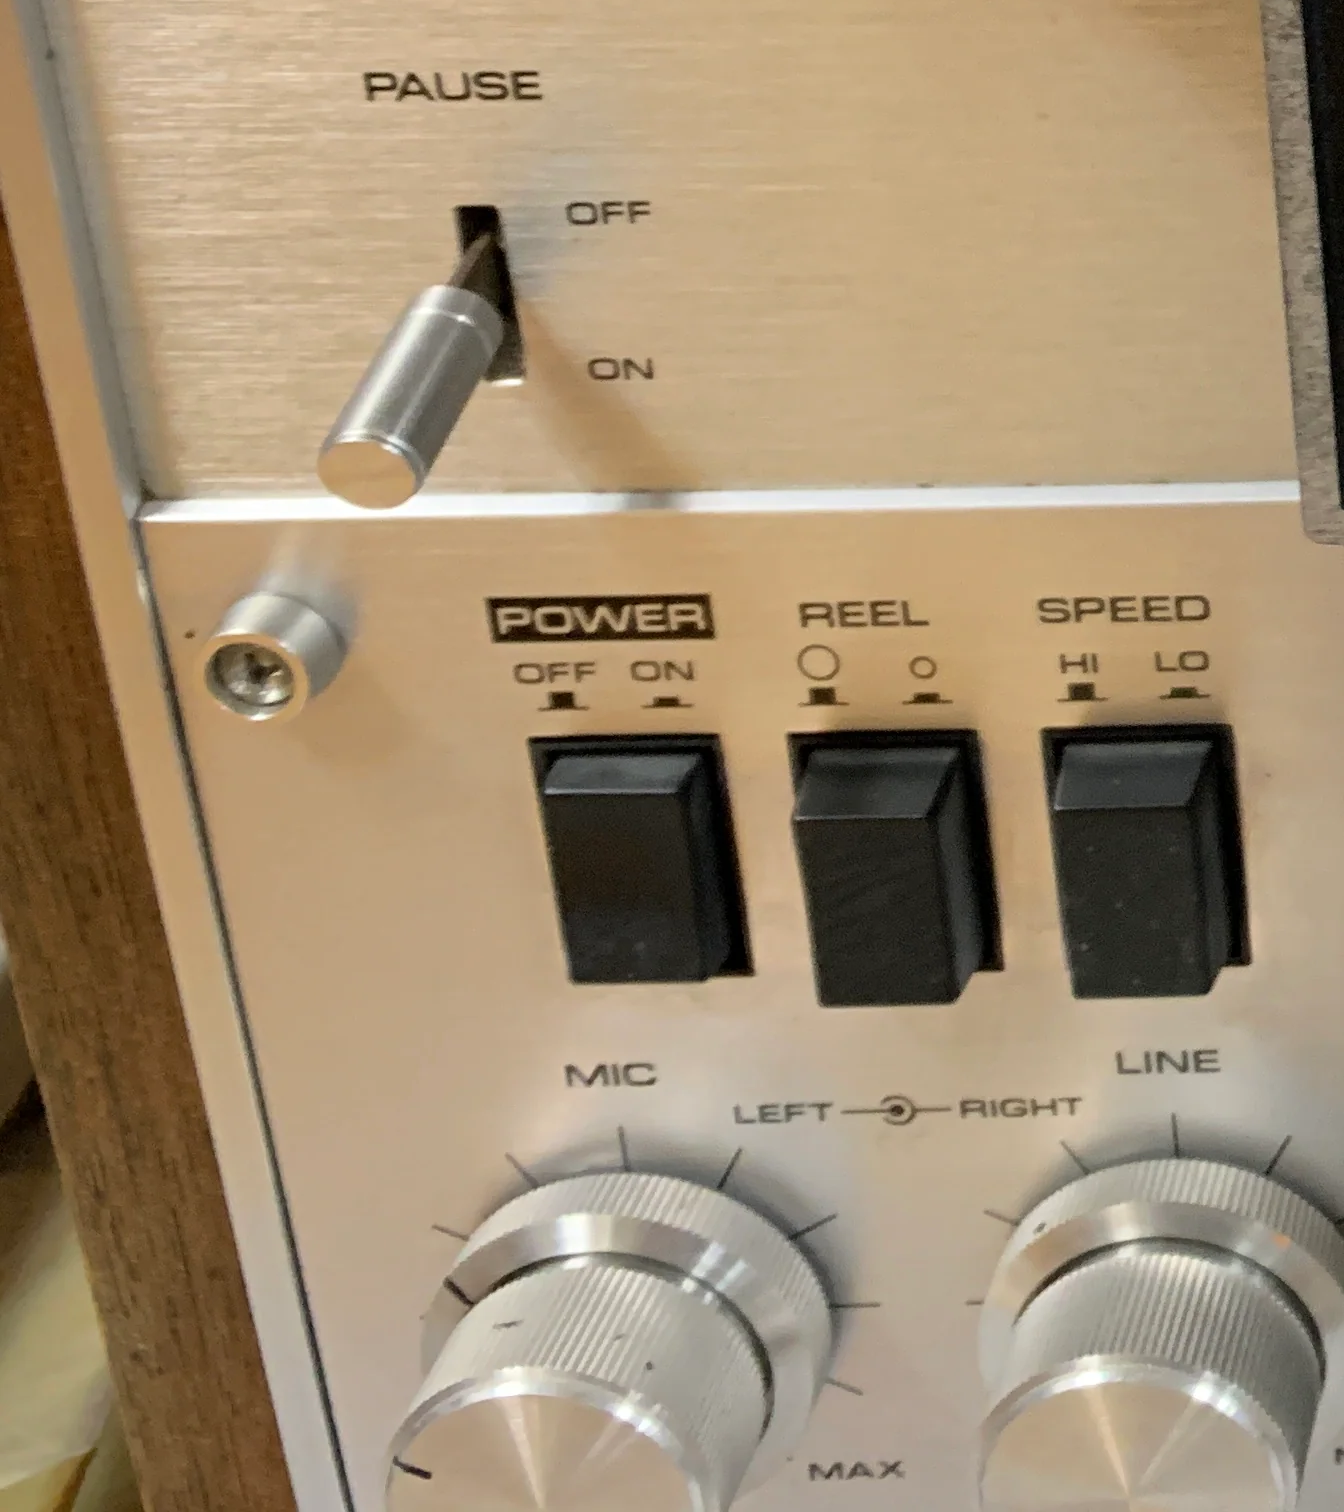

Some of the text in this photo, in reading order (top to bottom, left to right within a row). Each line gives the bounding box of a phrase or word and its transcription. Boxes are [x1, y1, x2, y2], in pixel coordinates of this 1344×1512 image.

[363, 71, 543, 102] PAUSE
[564, 200, 651, 226] OFF
[587, 357, 654, 381] ON
[495, 602, 709, 635] POWER
[799, 600, 929, 628] REEL
[1037, 595, 1211, 624] SPEED
[513, 658, 695, 685] OFF ON
[1059, 648, 1210, 675] HI LO
[564, 1062, 659, 1089] MIC
[1115, 1048, 1221, 1076] LINE
[733, 1096, 1083, 1126] LEFT RIGHT
[808, 1461, 905, 1482] MAX
